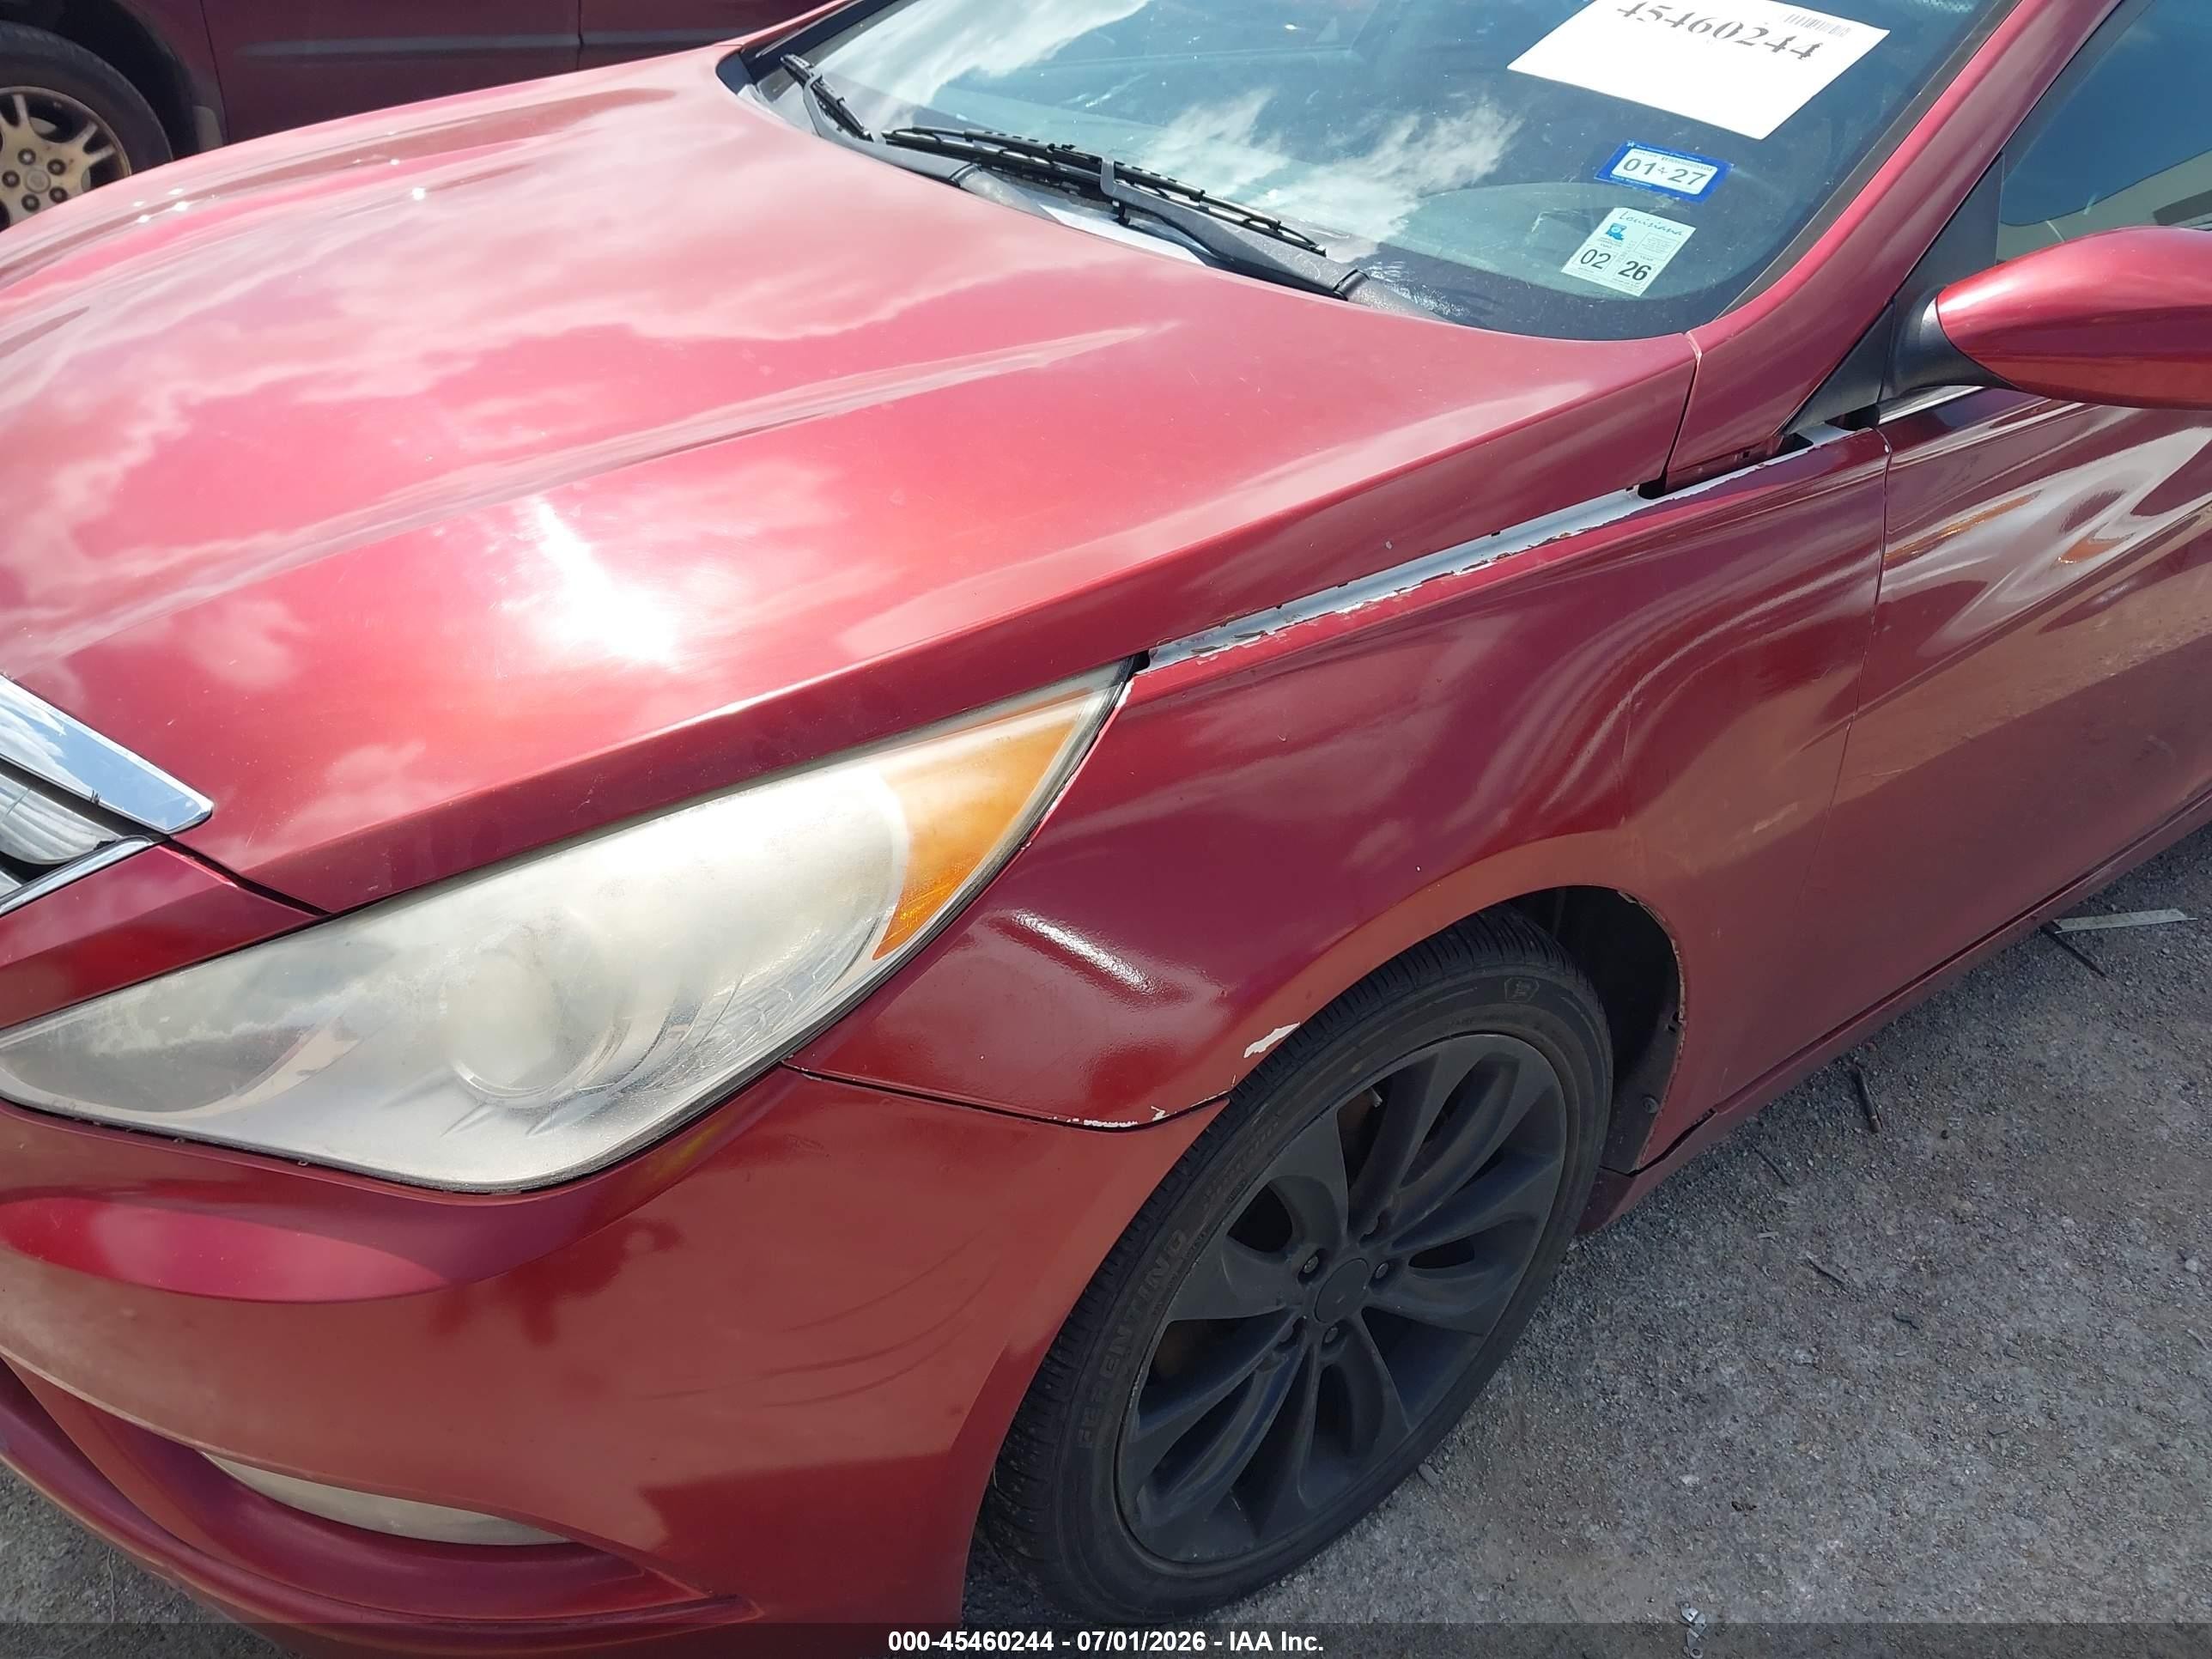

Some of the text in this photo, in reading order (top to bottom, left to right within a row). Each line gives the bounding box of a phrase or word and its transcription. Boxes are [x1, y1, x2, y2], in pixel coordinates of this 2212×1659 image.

[1616, 1, 1824, 60] 45460244
[1623, 157, 1657, 176] 01
[1667, 167, 1707, 186] 27
[1579, 248, 1612, 270] 02
[1617, 260, 1652, 282] 26
